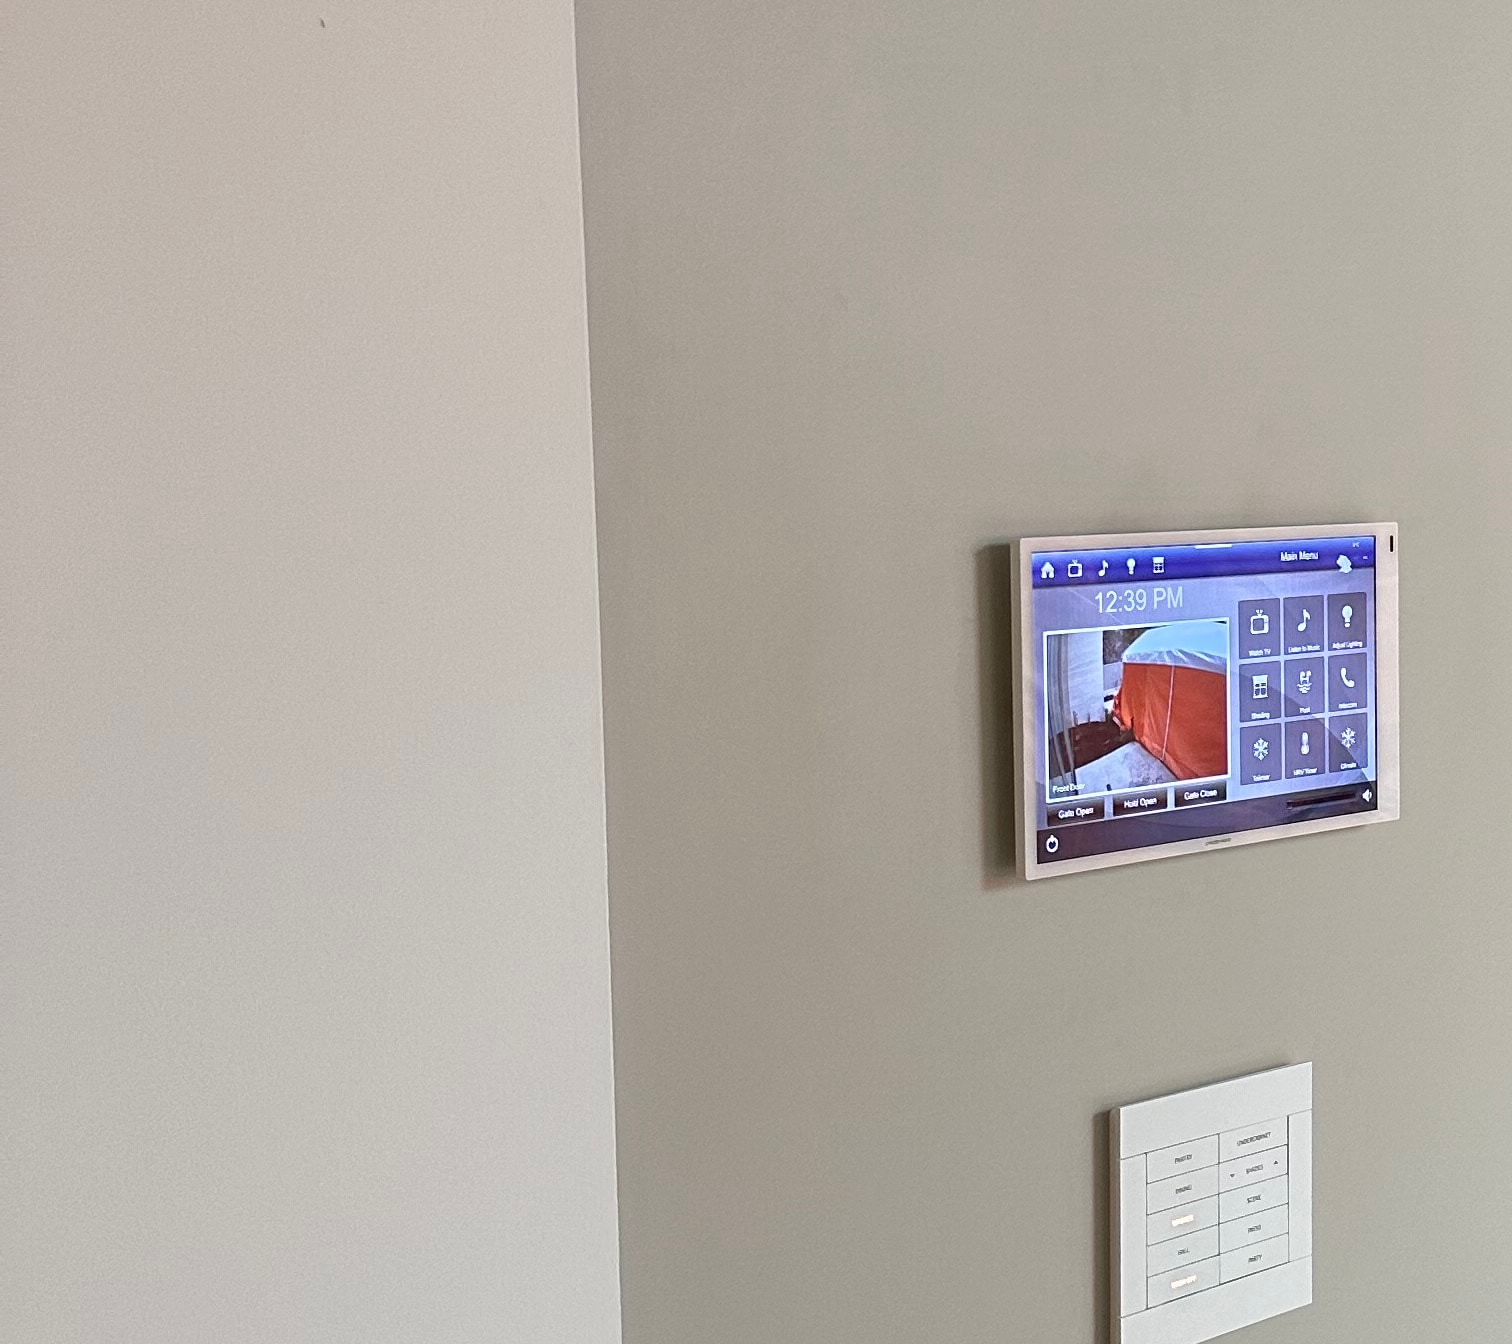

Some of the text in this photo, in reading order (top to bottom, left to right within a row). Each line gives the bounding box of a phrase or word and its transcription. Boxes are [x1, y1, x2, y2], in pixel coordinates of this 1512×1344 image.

[1280, 550, 1319, 562] Main Menu
[1094, 585, 1183, 614] 12:39 PM
[1139, 796, 1158, 807] Open
[1075, 806, 1094, 818] Open
